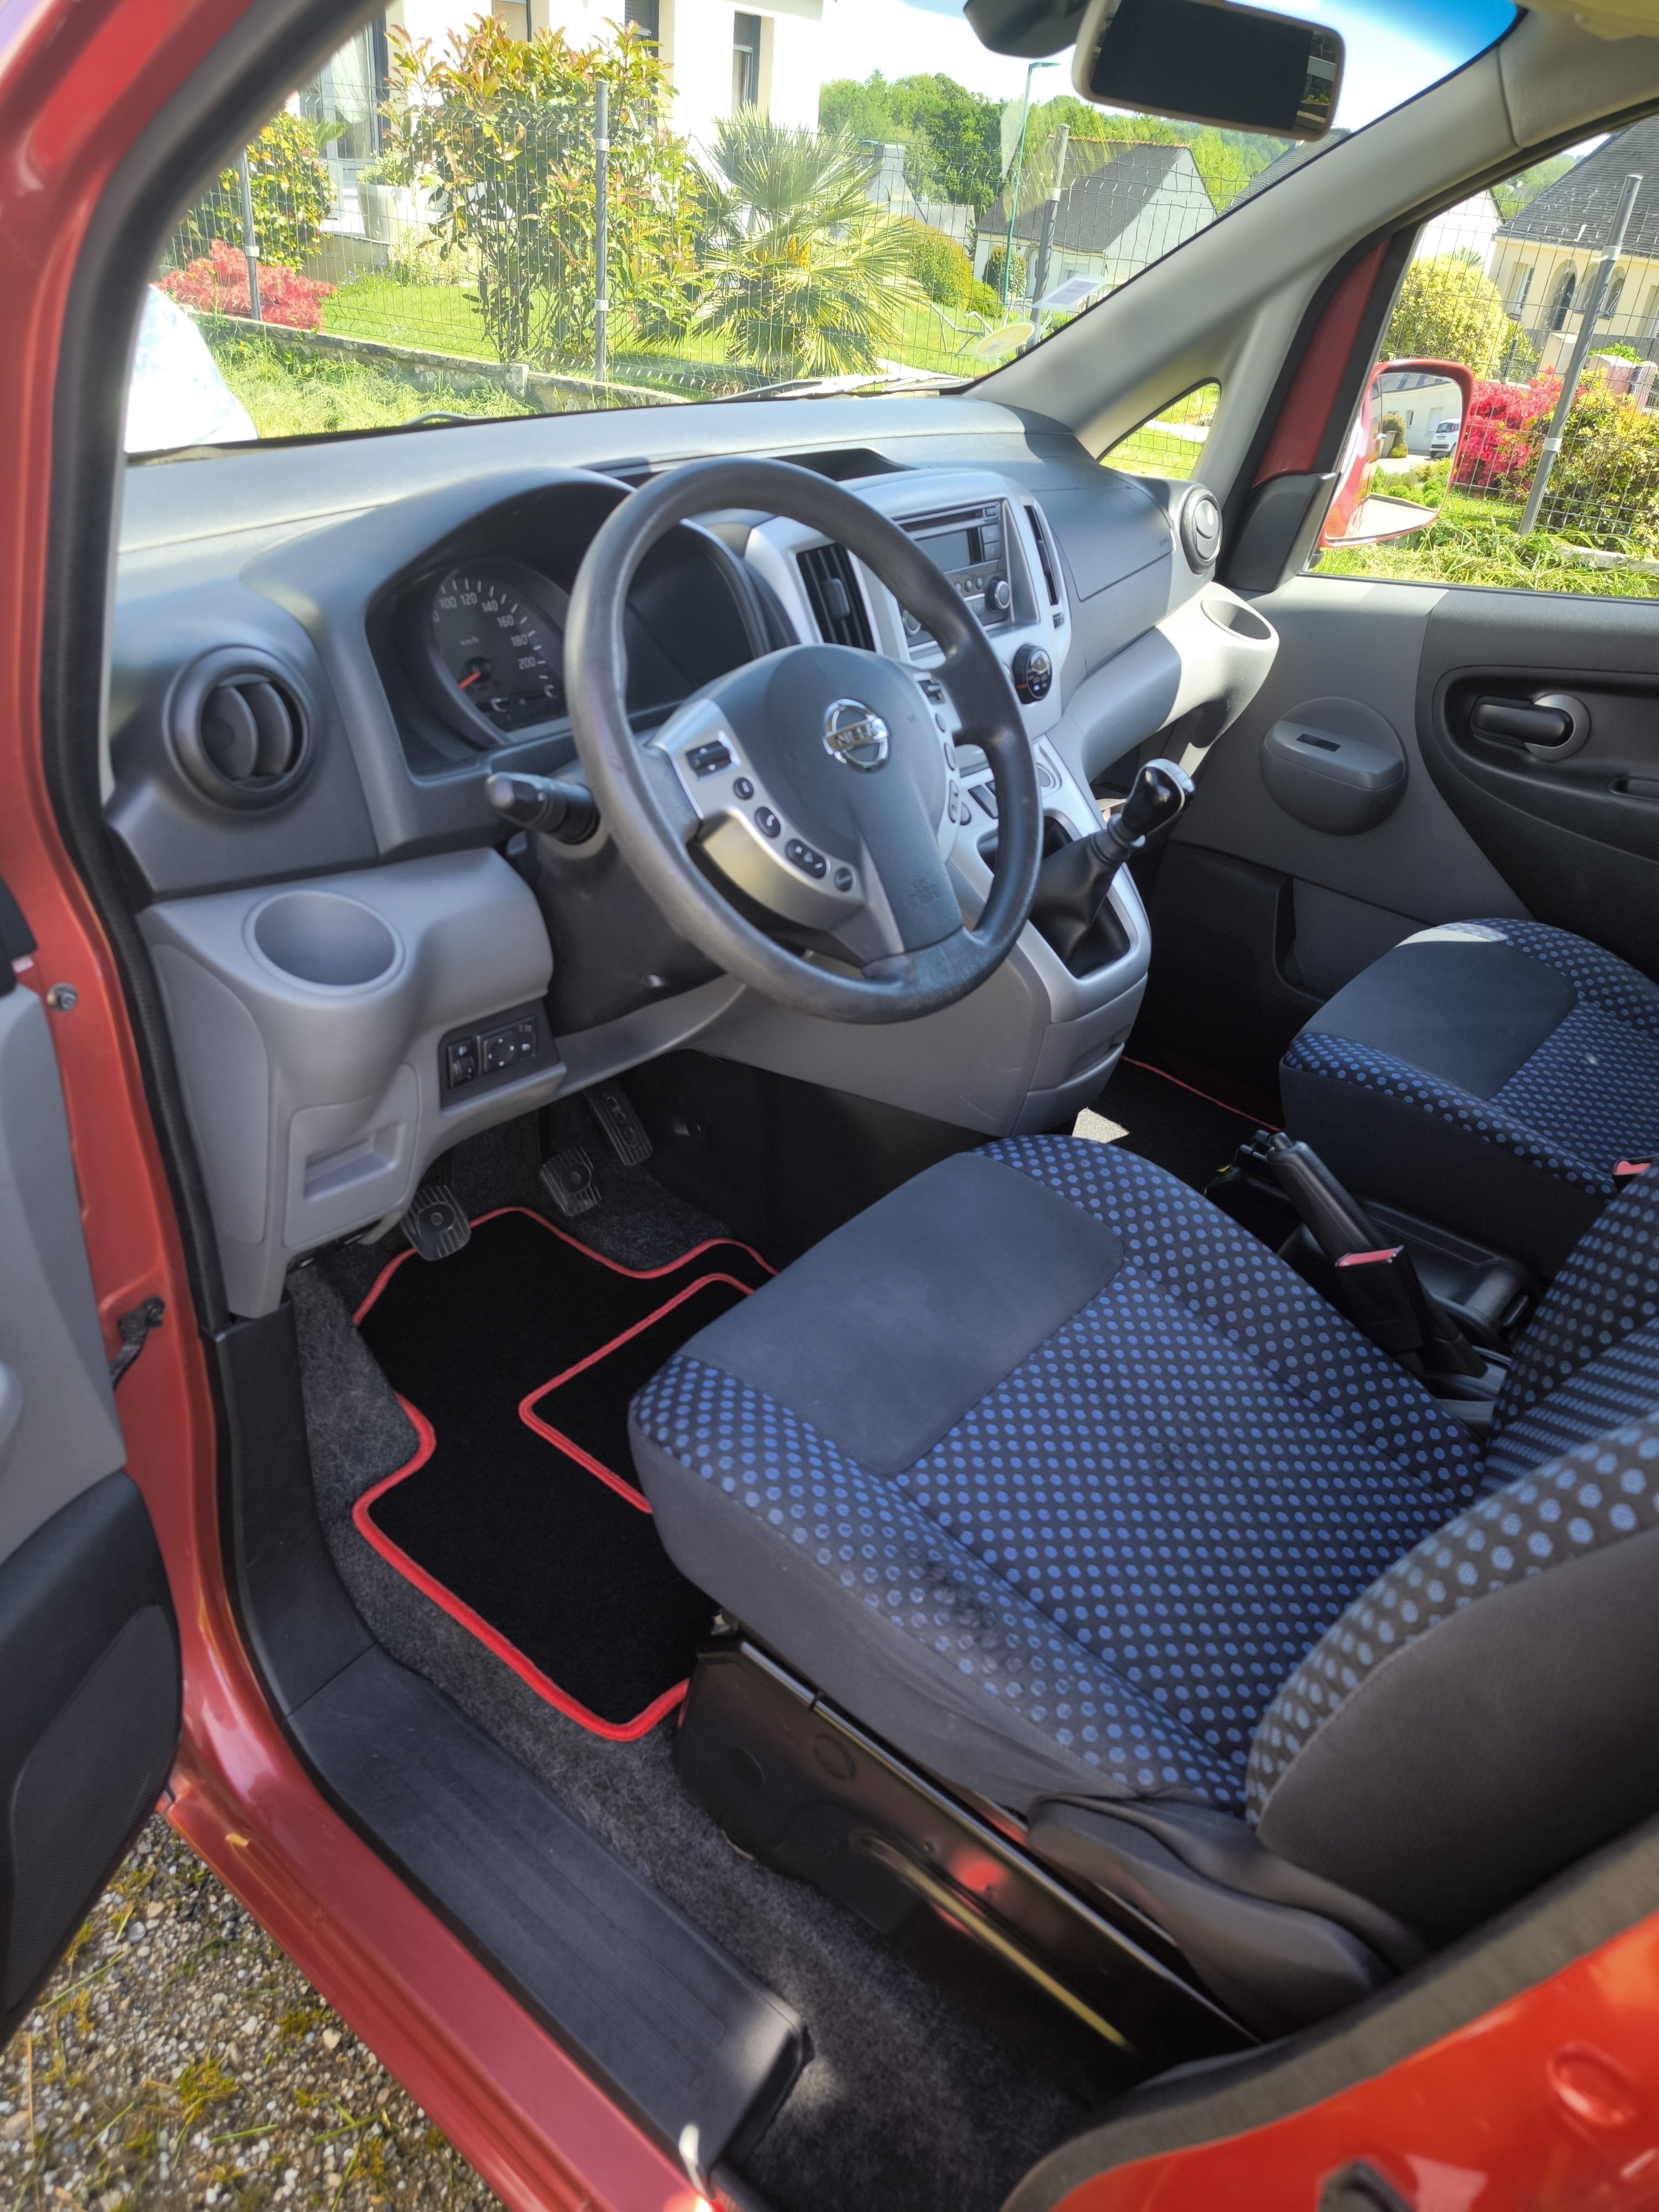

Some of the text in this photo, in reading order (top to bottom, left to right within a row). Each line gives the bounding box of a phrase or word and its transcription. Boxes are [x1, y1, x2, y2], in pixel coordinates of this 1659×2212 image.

[439, 596, 457, 609] 100
[461, 592, 477, 605] 120
[481, 599, 498, 613] 140
[433, 610, 440, 622] 0
[497, 615, 514, 628] 160
[511, 635, 528, 646] 180
[518, 656, 536, 670] 200
[835, 721, 882, 746] NISS
